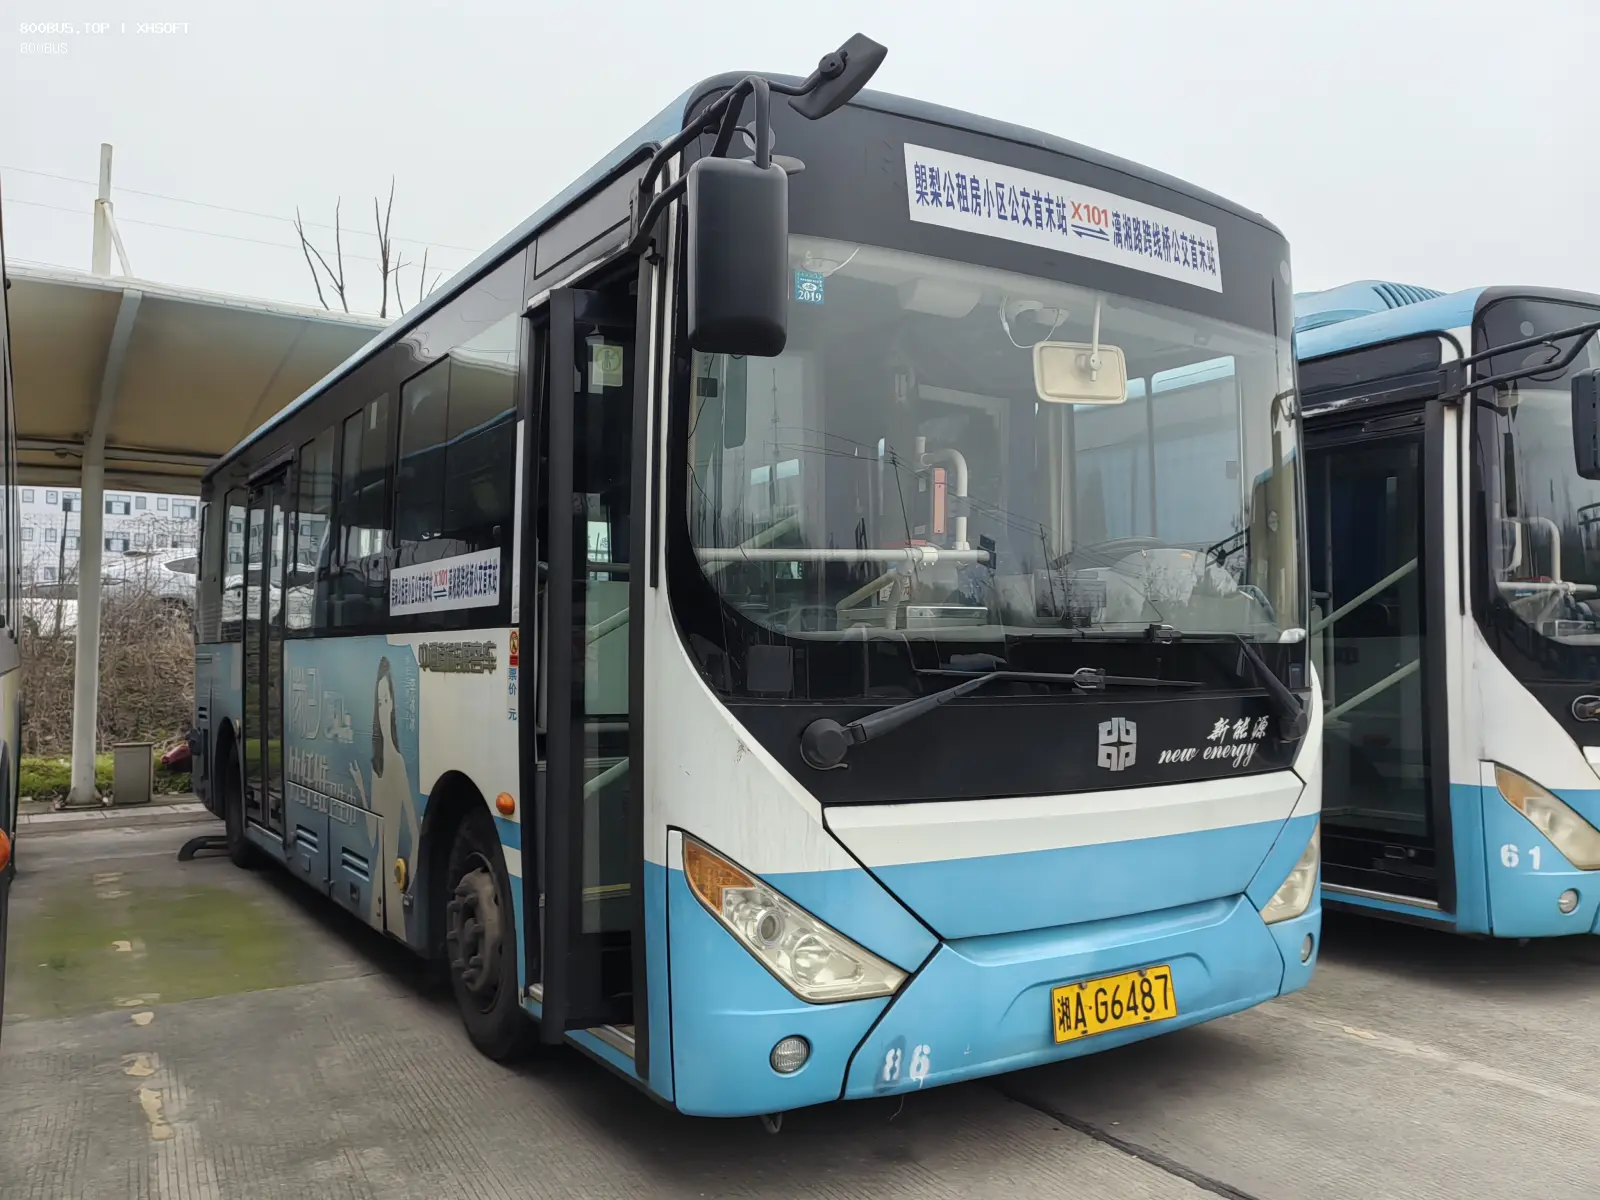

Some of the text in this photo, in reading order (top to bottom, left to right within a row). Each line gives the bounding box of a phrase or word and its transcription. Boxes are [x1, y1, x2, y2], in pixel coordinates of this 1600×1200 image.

[1071, 201, 1109, 228] X101
[798, 290, 822, 302] 2019
[508, 668, 517, 720] 票价 元
[1207, 715, 1269, 743] 新能源
[1158, 742, 1260, 768] new energy
[1500, 843, 1541, 870] 61
[883, 1044, 931, 1083] 86
